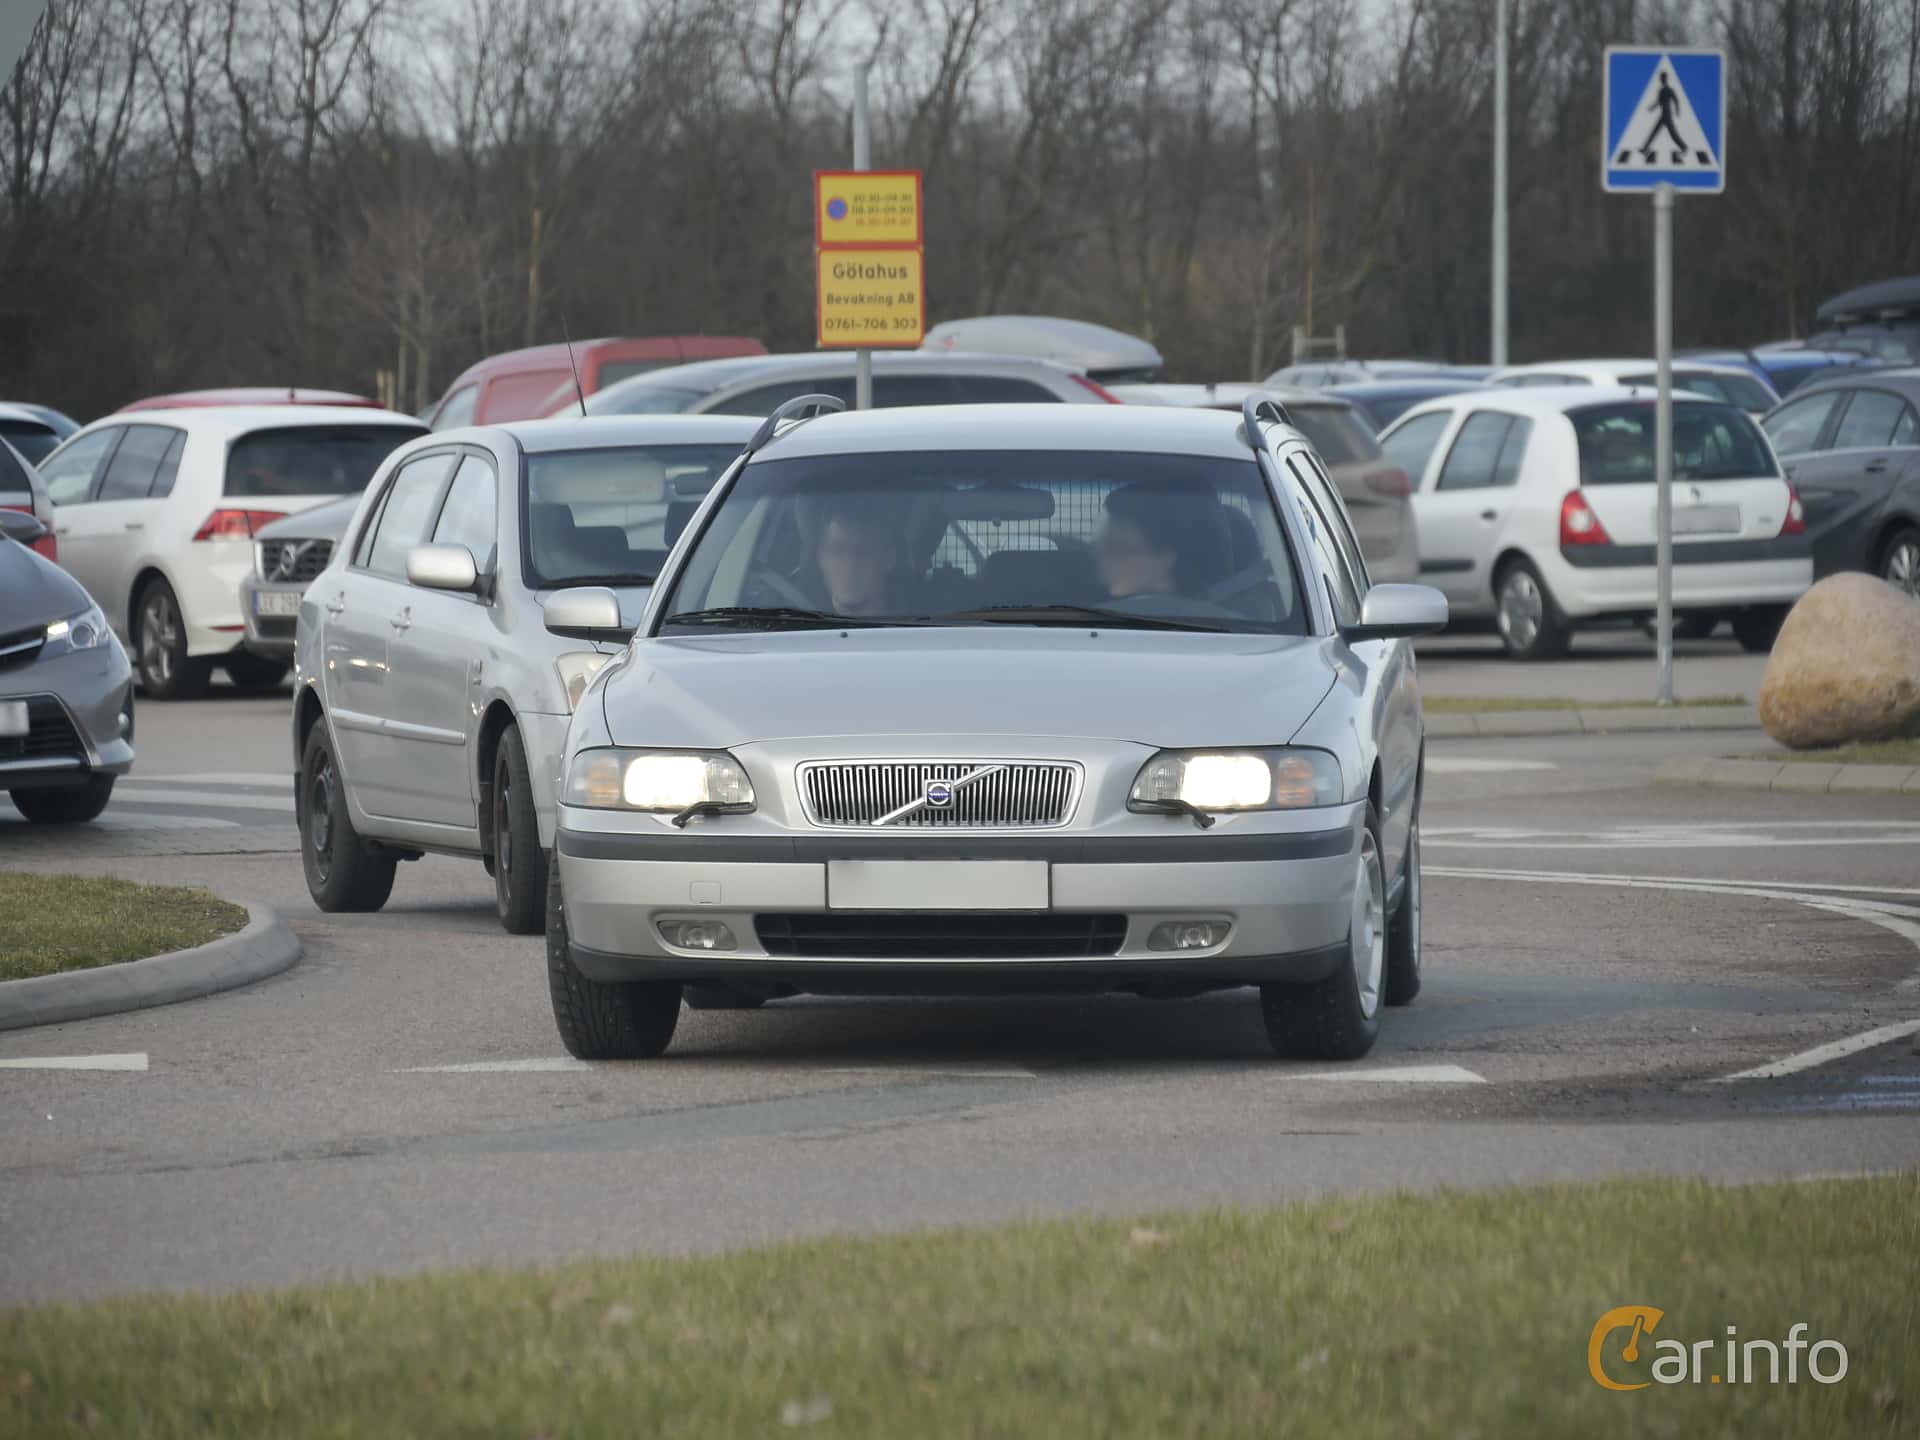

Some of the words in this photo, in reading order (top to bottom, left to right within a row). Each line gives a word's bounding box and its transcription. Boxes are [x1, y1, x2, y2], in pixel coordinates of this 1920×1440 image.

[833, 262, 908, 280] Götahus
[827, 293, 894, 306] Bevakning
[898, 292, 915, 304] AB
